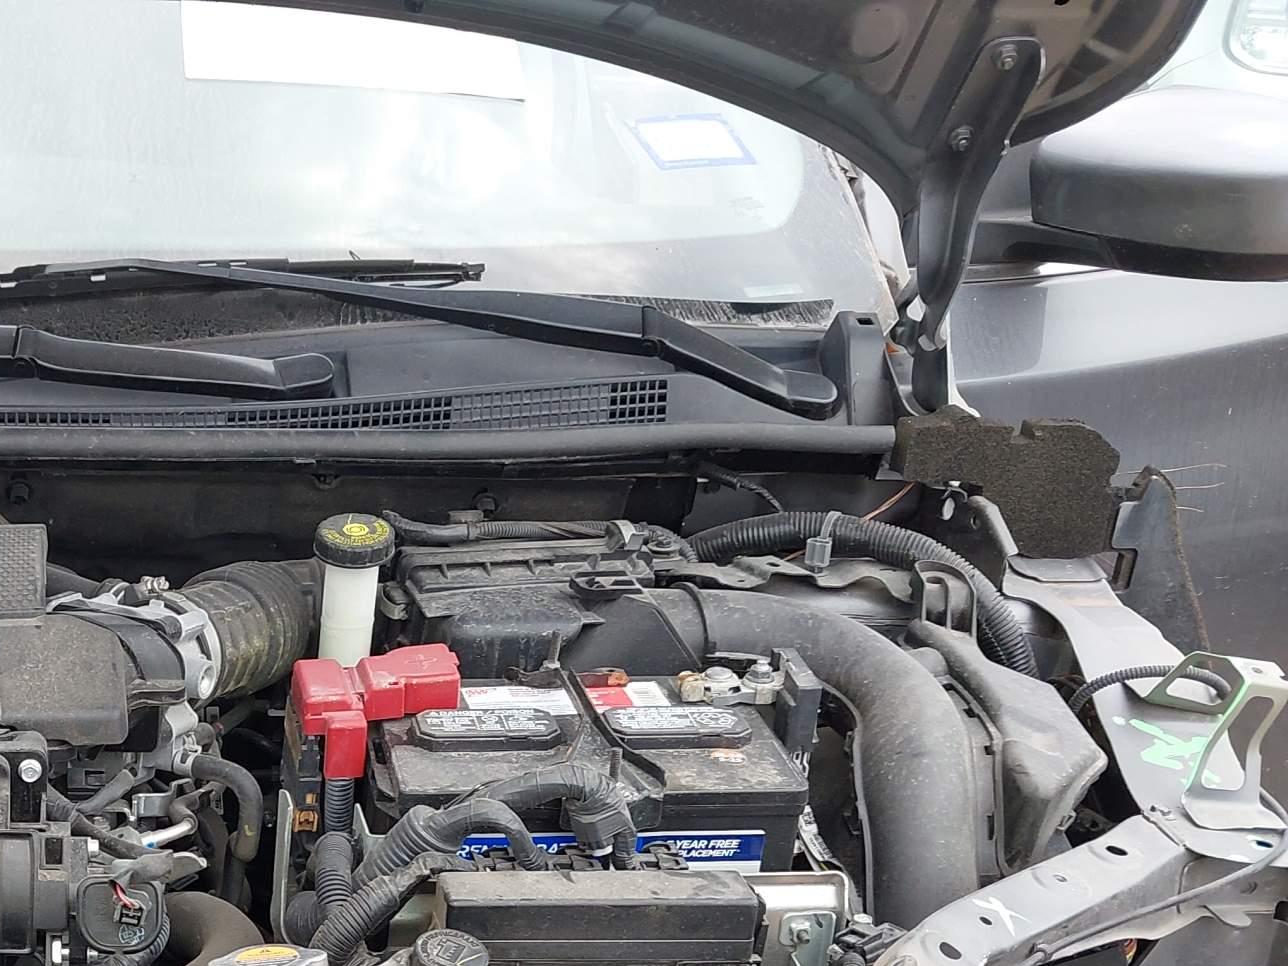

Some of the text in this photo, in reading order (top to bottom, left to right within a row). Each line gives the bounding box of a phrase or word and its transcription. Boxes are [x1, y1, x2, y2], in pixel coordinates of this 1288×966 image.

[677, 840, 705, 848] YEAR
[708, 840, 740, 848] FREE
[679, 849, 736, 857] PLACEMENT
